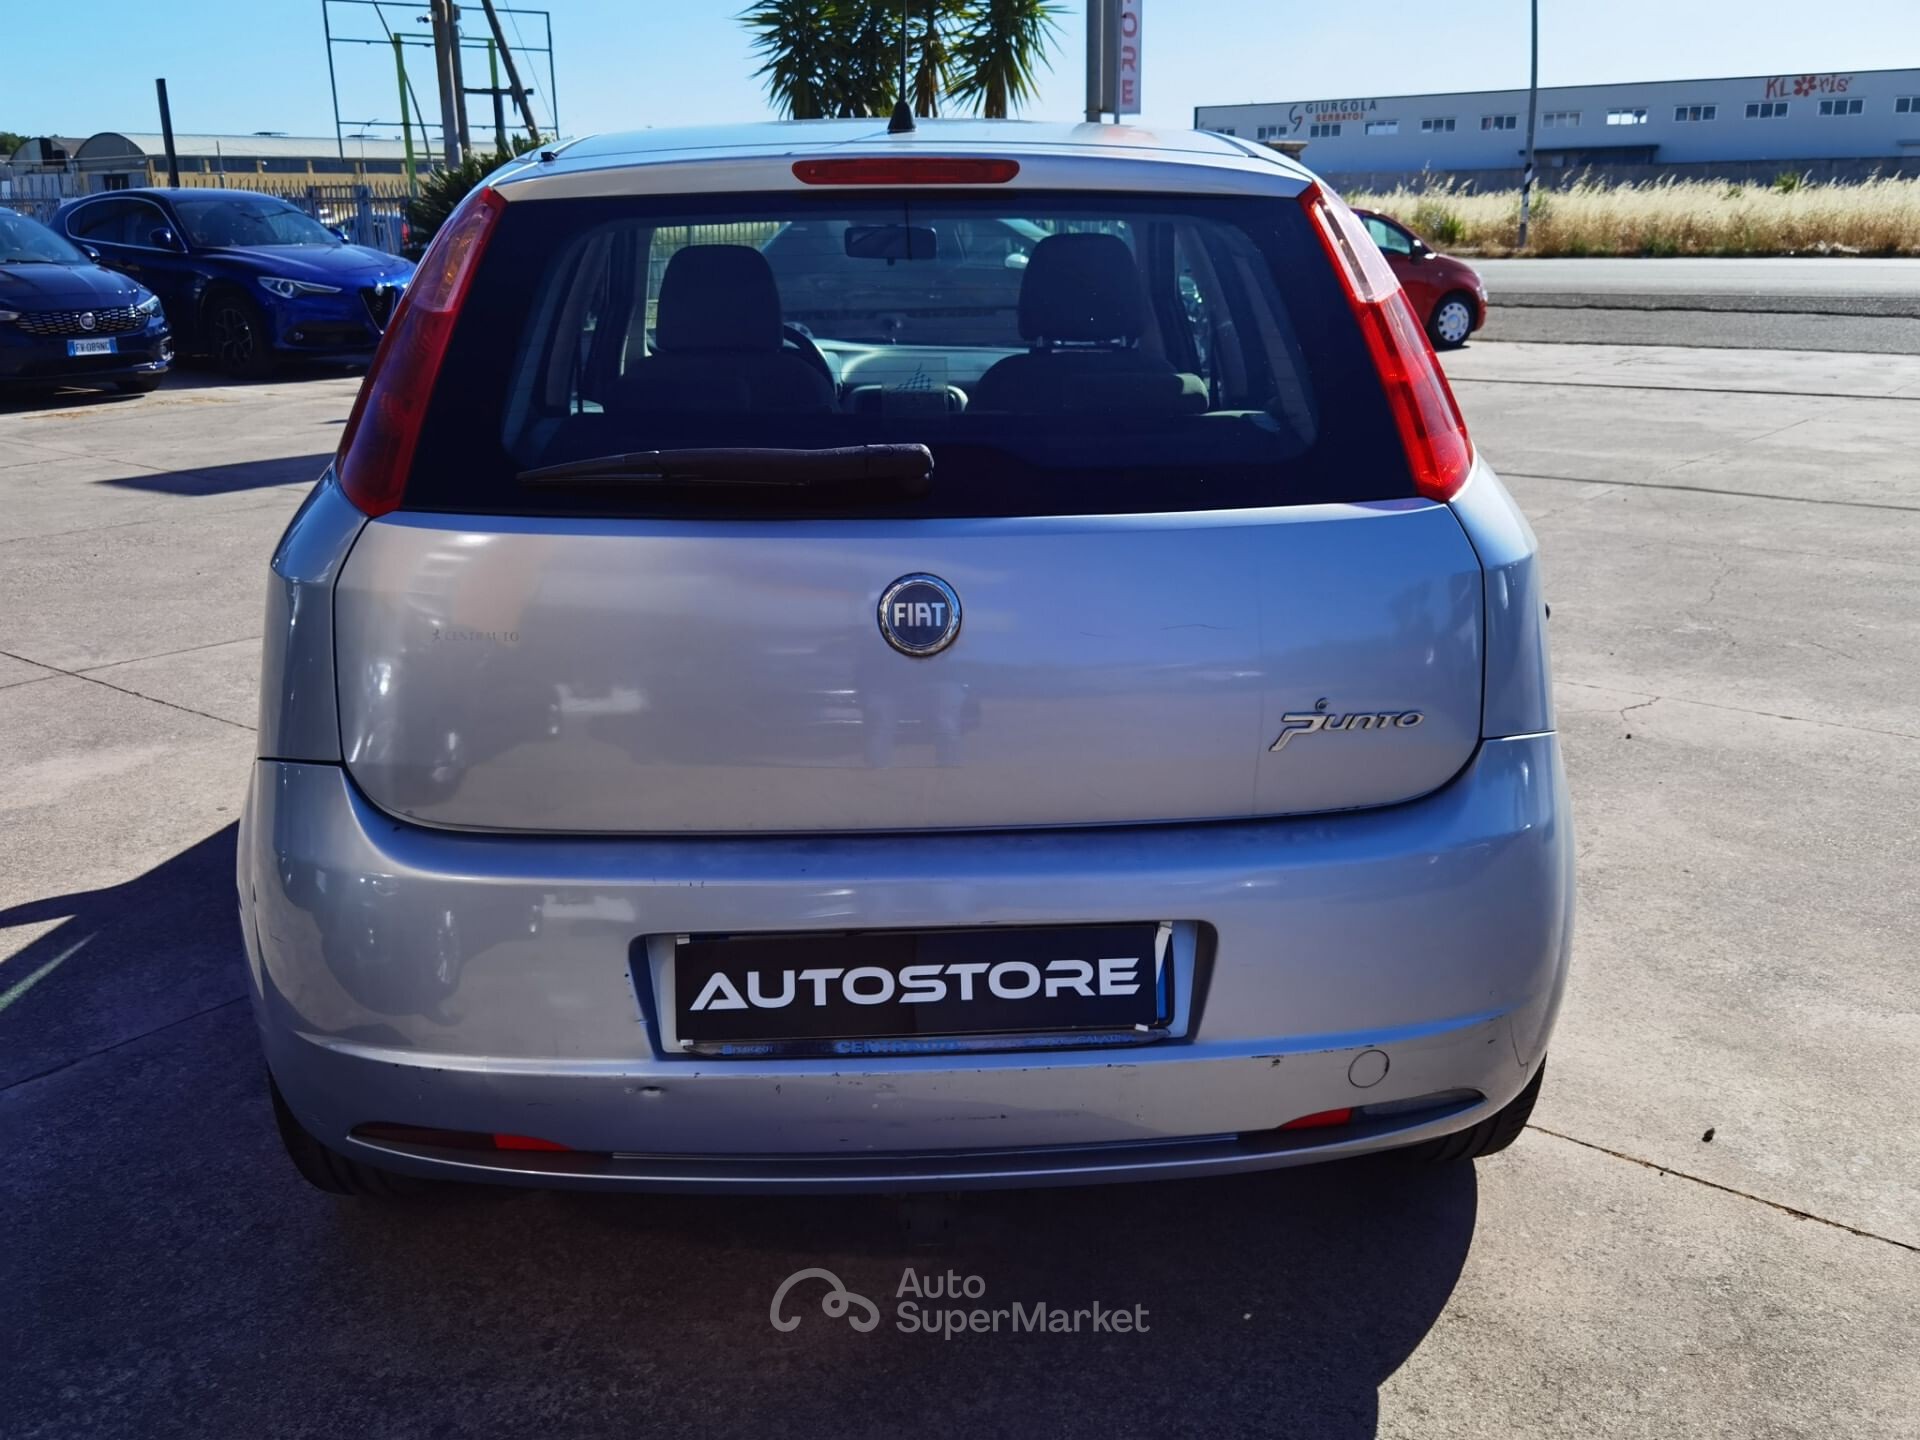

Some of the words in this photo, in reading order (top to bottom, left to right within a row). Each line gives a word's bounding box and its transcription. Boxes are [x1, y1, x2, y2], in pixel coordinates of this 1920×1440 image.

[1121, 0, 1138, 106] ORE
[1305, 100, 1377, 114] GIURGOLA
[893, 602, 946, 627] FIAT
[688, 956, 1142, 1012] AUTOSTORE
